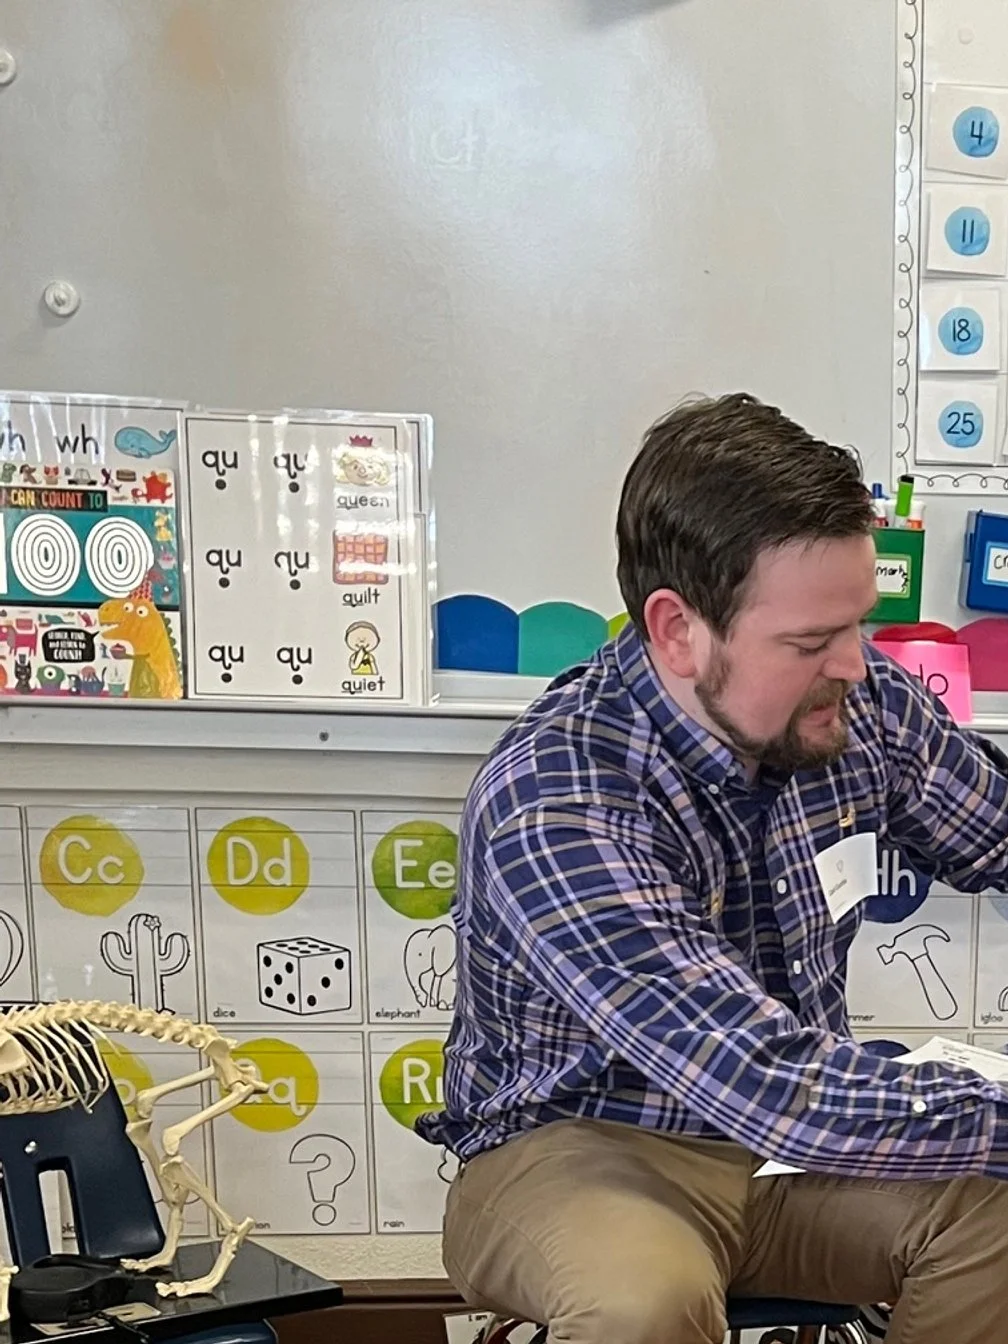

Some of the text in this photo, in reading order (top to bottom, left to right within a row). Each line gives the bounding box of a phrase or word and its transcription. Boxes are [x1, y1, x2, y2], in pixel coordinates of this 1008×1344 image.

[969, 120, 984, 147] 4
[961, 219, 975, 244] 11
[952, 318, 971, 343] 18
[946, 411, 975, 436] 25
[55, 423, 99, 455] wh
[202, 450, 238, 476] qu
[11, 489, 35, 506] CAN
[41, 490, 83, 508] COUNT
[88, 493, 103, 508] TO
[337, 494, 389, 509] queen
[206, 549, 242, 575] qu
[343, 587, 380, 606] quilt
[208, 645, 244, 670] qu
[277, 647, 312, 671] qu
[342, 677, 385, 694] quiet
[57, 834, 126, 886] Cc
[226, 835, 293, 887] Dd
[394, 839, 456, 889] Ee
[213, 1006, 236, 1018] dice
[375, 1008, 421, 1020] elephant
[981, 1011, 1003, 1024] igloo
[383, 1219, 405, 1228] rain
